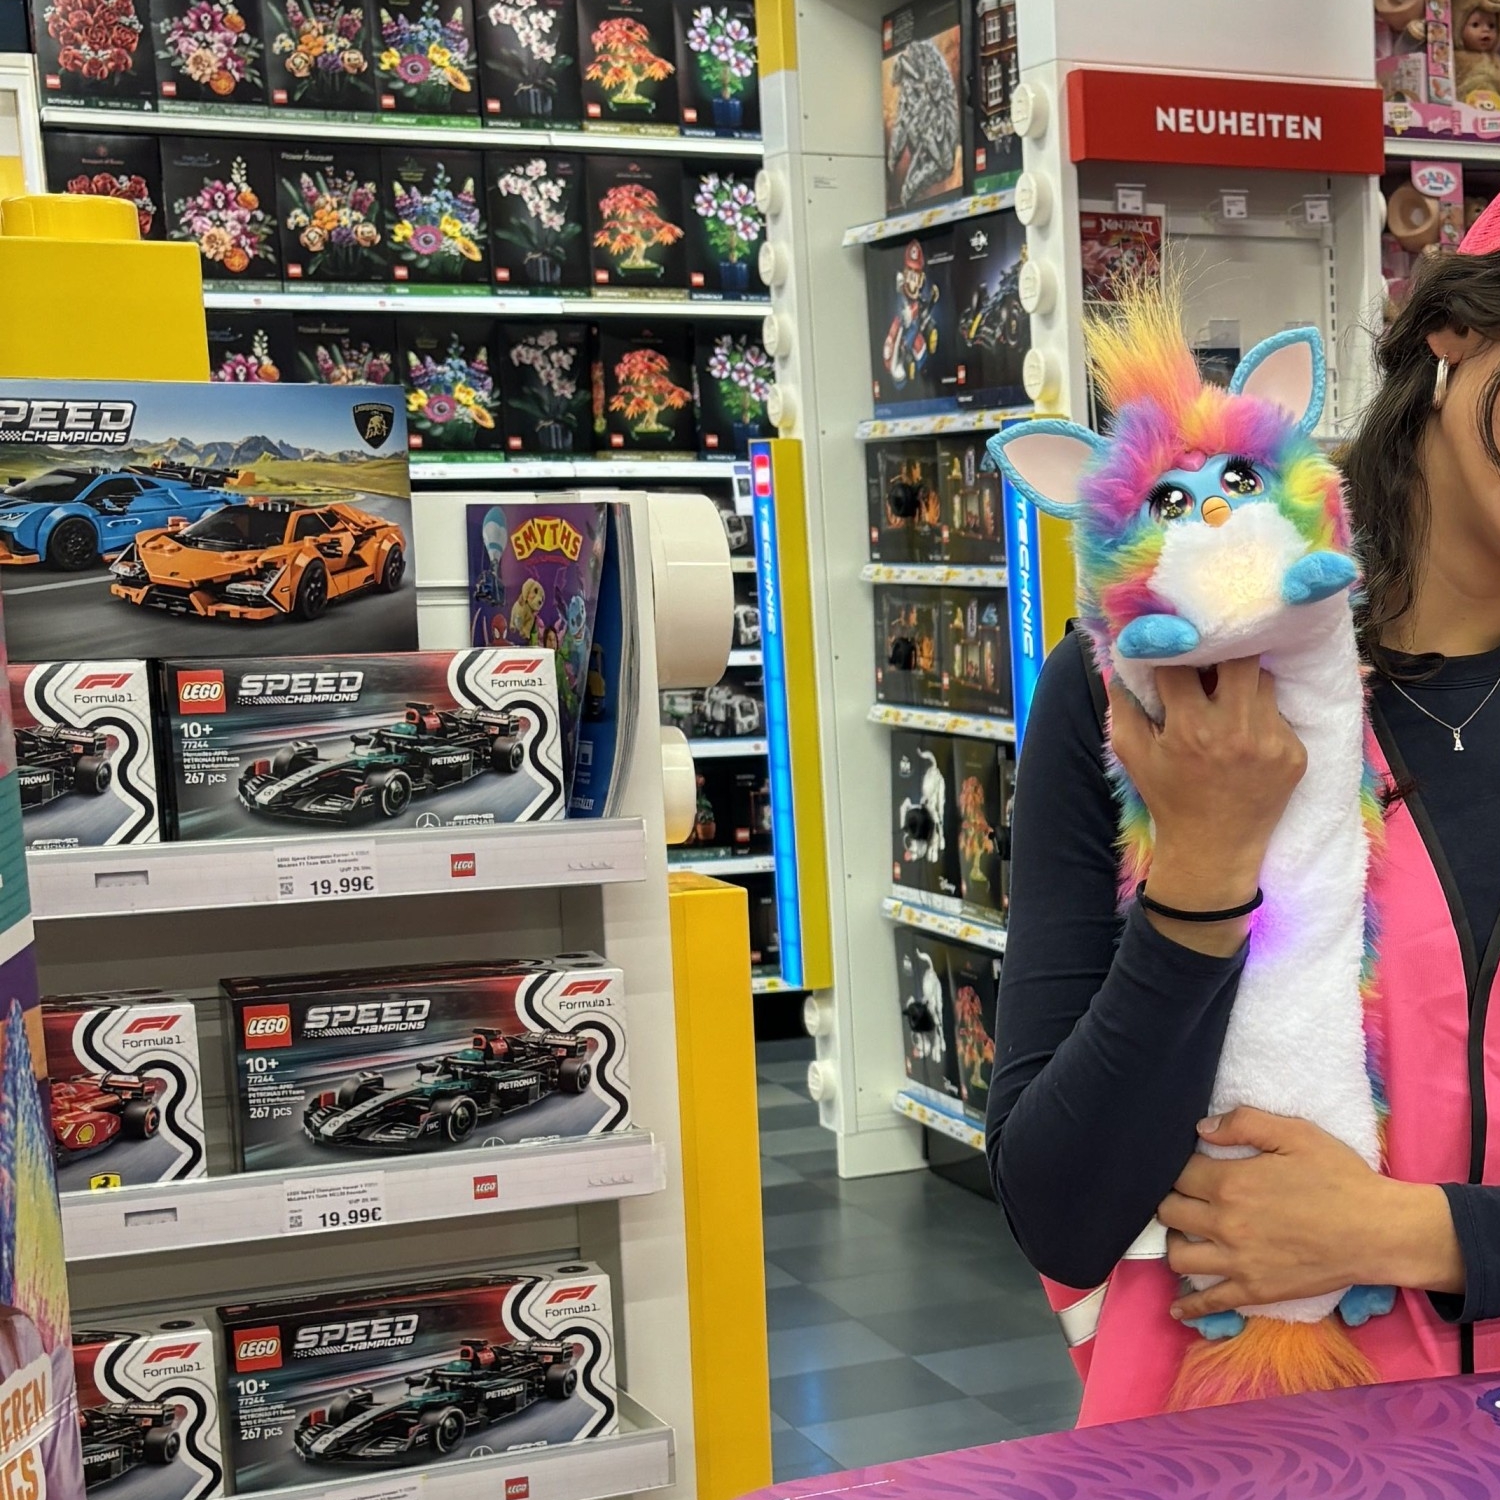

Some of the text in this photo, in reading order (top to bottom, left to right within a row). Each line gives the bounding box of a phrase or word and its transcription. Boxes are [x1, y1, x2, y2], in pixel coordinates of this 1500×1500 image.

[1156, 106, 1323, 141] NEUHEITEN
[513, 524, 581, 560] SMYTHS
[238, 671, 364, 695] SPEED
[181, 683, 223, 701] LEGO
[180, 721, 214, 738] 10+
[431, 753, 470, 766] PETRONAS
[20, 773, 51, 786] TRONAS
[184, 772, 228, 786] 267 pcs
[453, 860, 474, 871] LEGO
[304, 999, 431, 1029] SPEED
[249, 1017, 287, 1035] LEGO
[246, 1057, 279, 1073] 10+
[498, 1076, 537, 1090] PETRONAS
[250, 1106, 292, 1119] 267 pcs
[476, 1182, 497, 1194] LEGO
[318, 1206, 382, 1228] 19.99€
[293, 1314, 419, 1350] SPEED
[239, 1339, 278, 1358] LEGO
[236, 1378, 270, 1395] 10+
[485, 1383, 524, 1400] PETRONAS
[241, 1426, 284, 1442] 267 pcs
[83, 1448, 120, 1466] ETRONAS
[506, 1482, 528, 1494] LEGO
